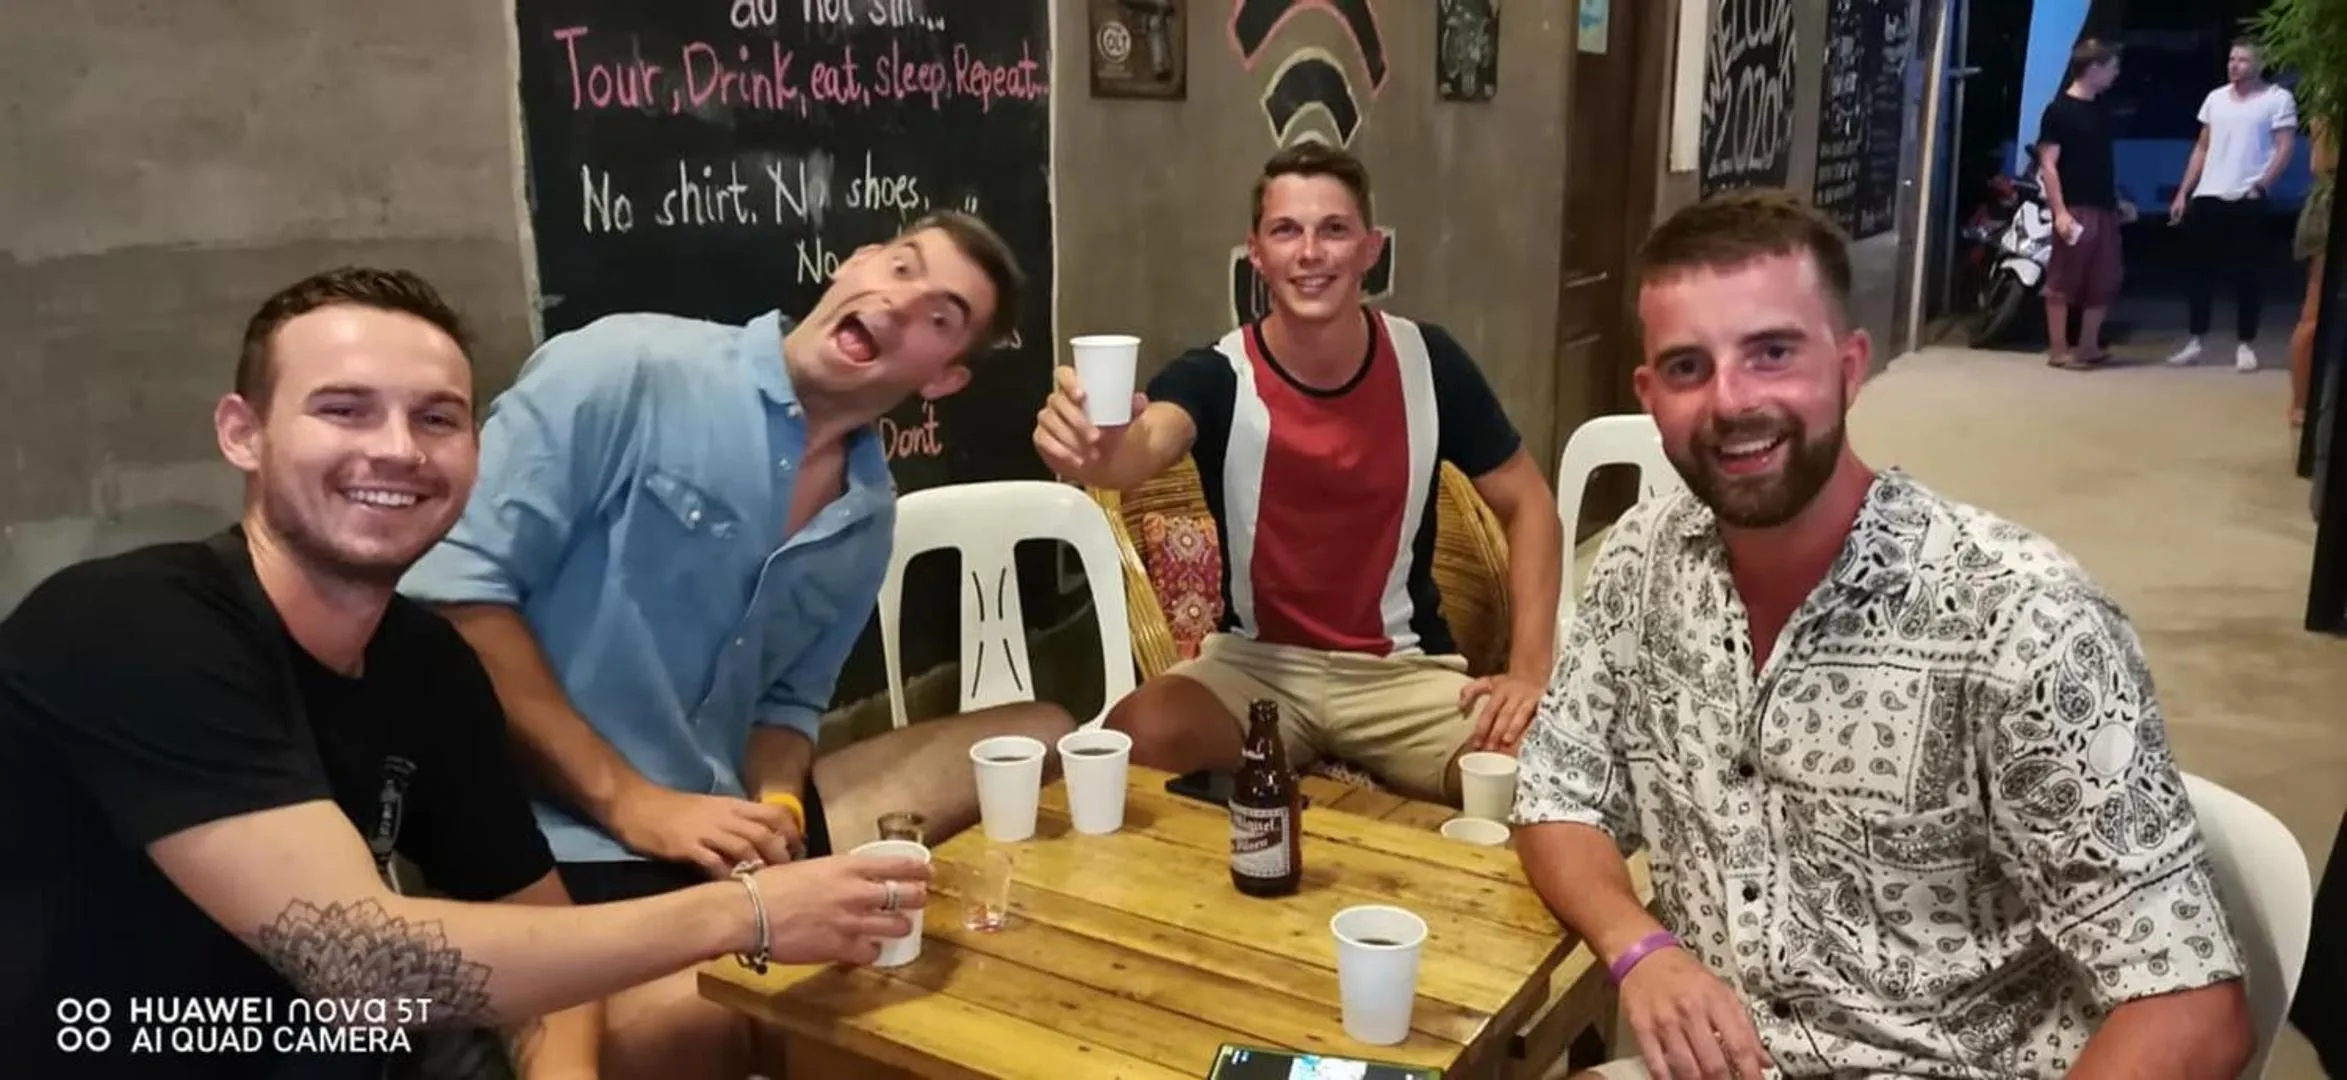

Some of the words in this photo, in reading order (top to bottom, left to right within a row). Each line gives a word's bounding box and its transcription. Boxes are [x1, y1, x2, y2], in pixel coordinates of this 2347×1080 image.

[1707, 64, 1779, 179] 2020
[581, 163, 633, 233] No
[795, 236, 840, 284] No
